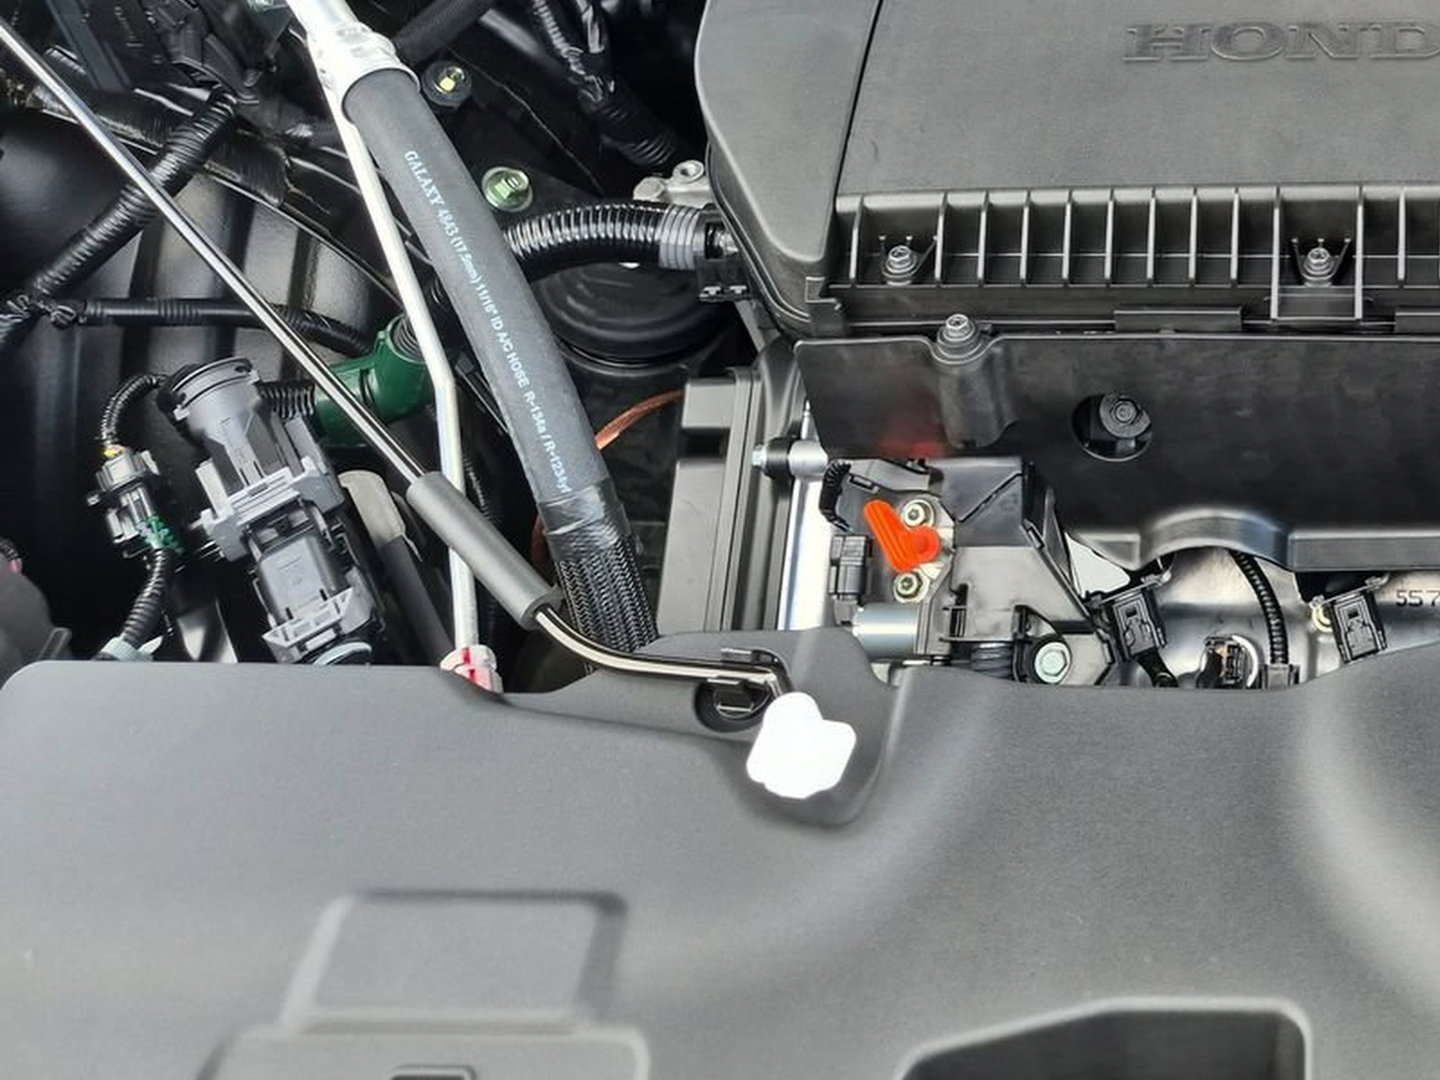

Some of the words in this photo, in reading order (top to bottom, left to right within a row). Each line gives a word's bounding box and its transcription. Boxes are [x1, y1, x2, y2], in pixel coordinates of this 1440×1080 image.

[404, 150, 445, 205] GALAXY
[491, 316, 504, 331] ID
[496, 331, 513, 352] A/C
[507, 352, 530, 388] HOSE
[523, 390, 547, 434] R-134a
